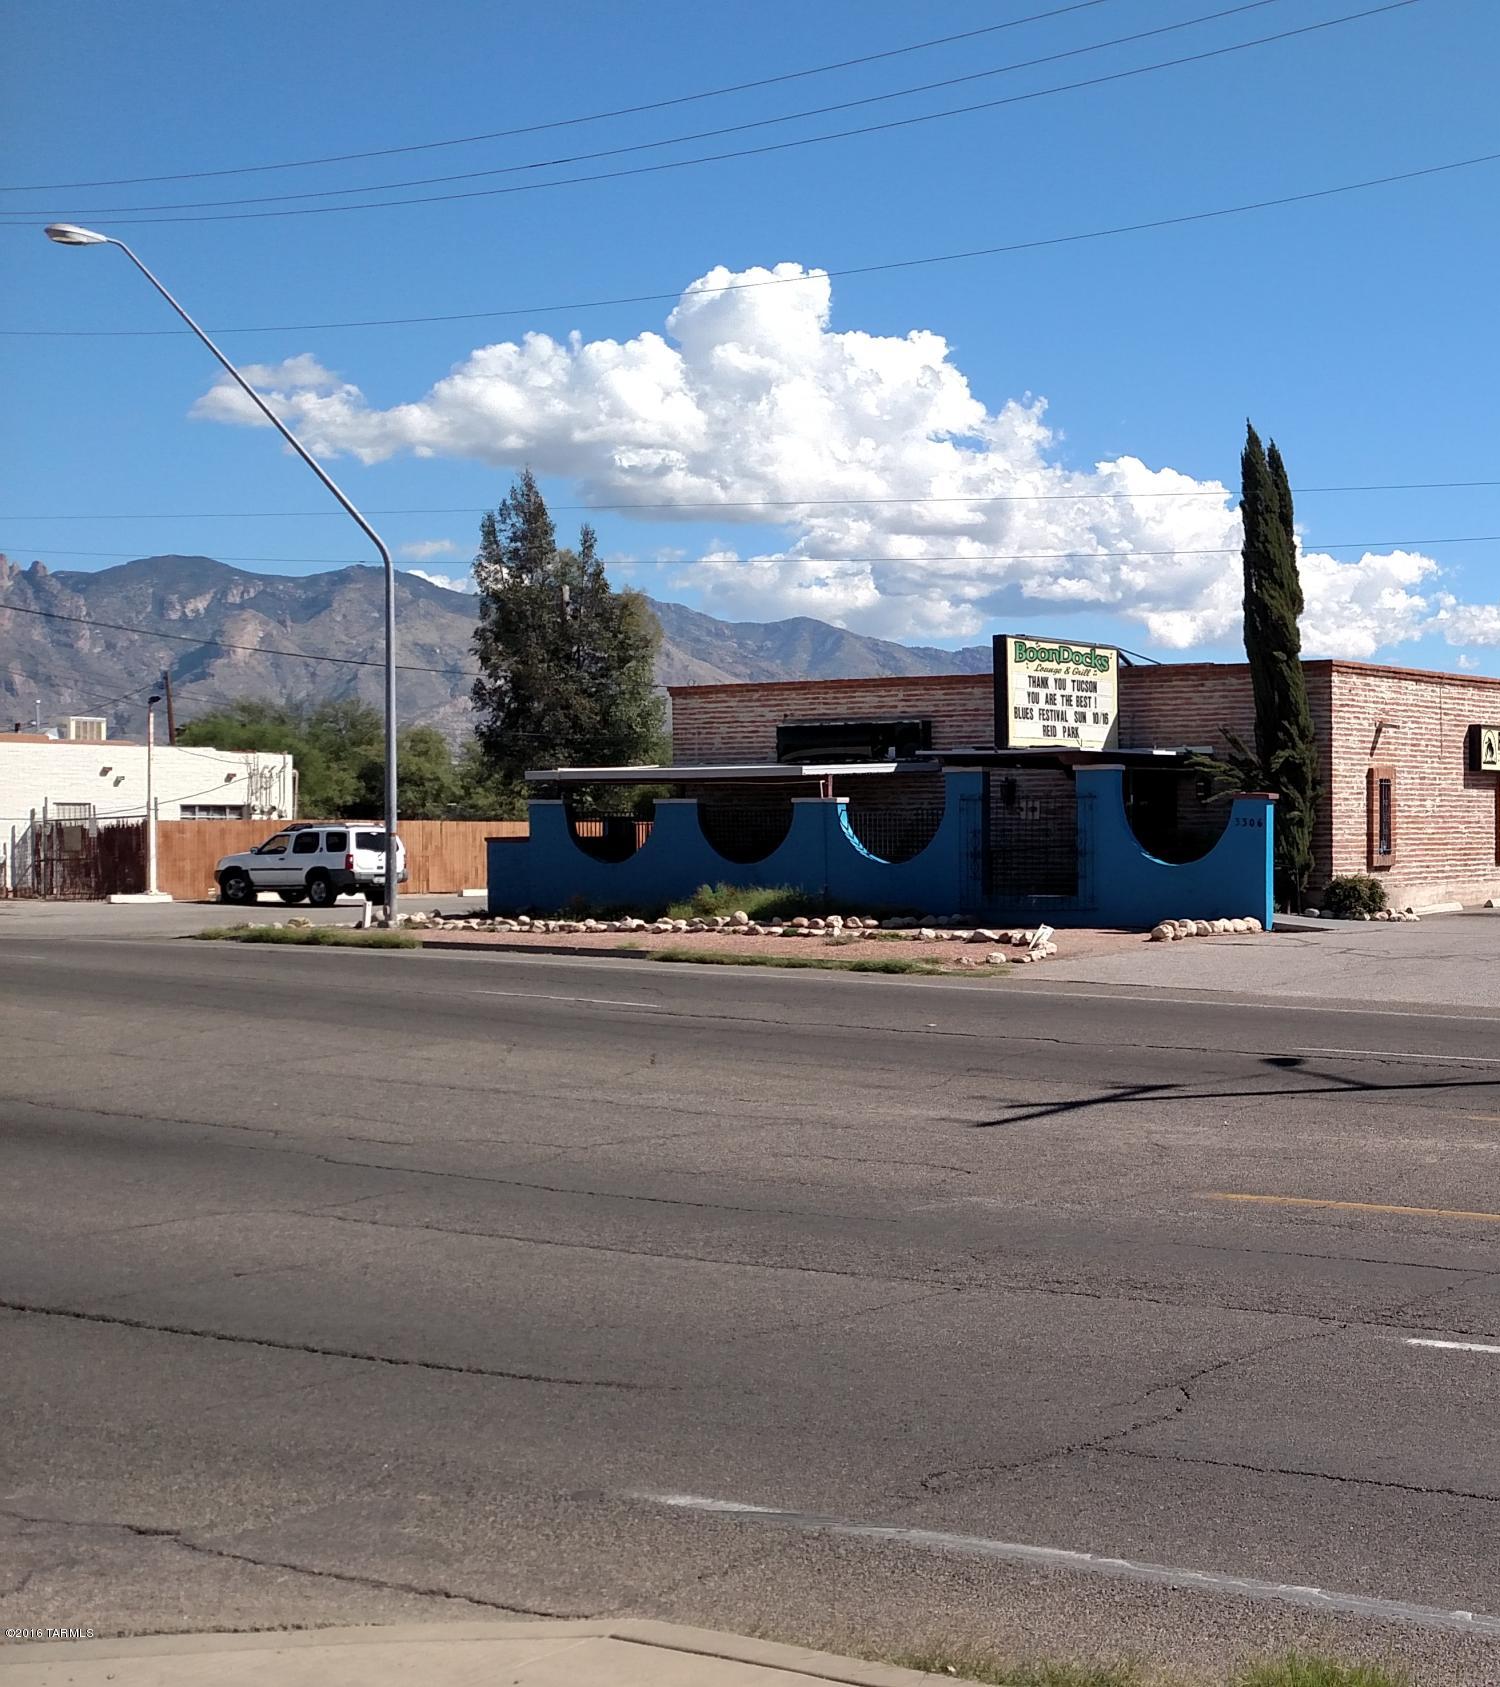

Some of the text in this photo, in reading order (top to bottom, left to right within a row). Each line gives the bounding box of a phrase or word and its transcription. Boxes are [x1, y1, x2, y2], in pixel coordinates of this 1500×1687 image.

[1033, 663, 1092, 677] Lounge & Grill
[1027, 675, 1098, 693] THANK YOU TUCSON
[1027, 691, 1040, 704] YOU
[1045, 693, 1057, 706] ARE
[1060, 694, 1073, 707] THE
[1076, 695, 1092, 708] BEST
[1014, 706, 1109, 725] BLUES FESTIVAL SUN 10/16
[1042, 724, 1080, 739] REID PARK
